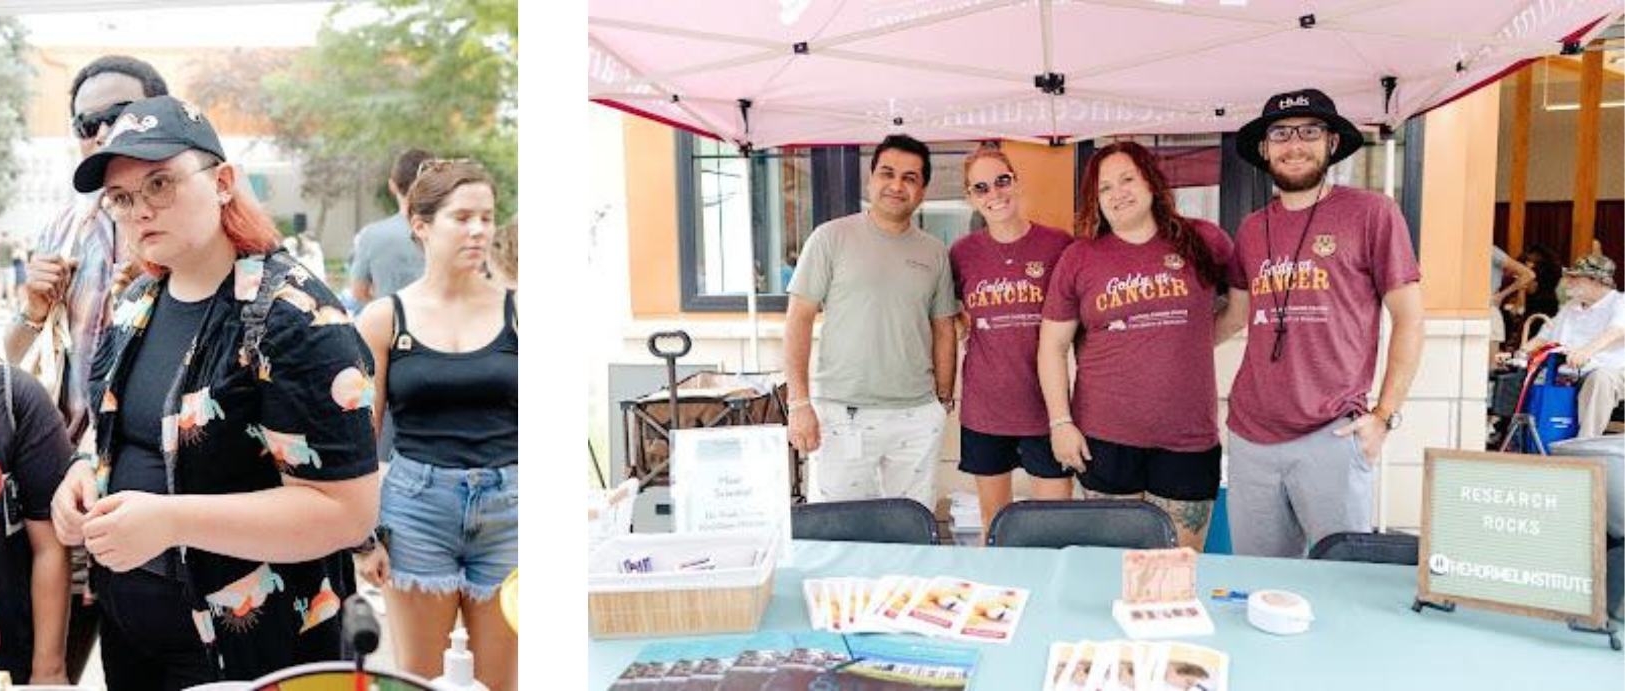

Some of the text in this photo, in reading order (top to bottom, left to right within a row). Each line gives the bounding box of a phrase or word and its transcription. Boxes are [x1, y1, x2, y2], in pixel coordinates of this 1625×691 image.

[1252, 267, 1330, 296] CANCER
[968, 284, 1044, 308] CANCER
[1096, 277, 1189, 311] CANCER
[1461, 486, 1559, 510] RESEARCH
[1483, 515, 1541, 536] ROCKS
